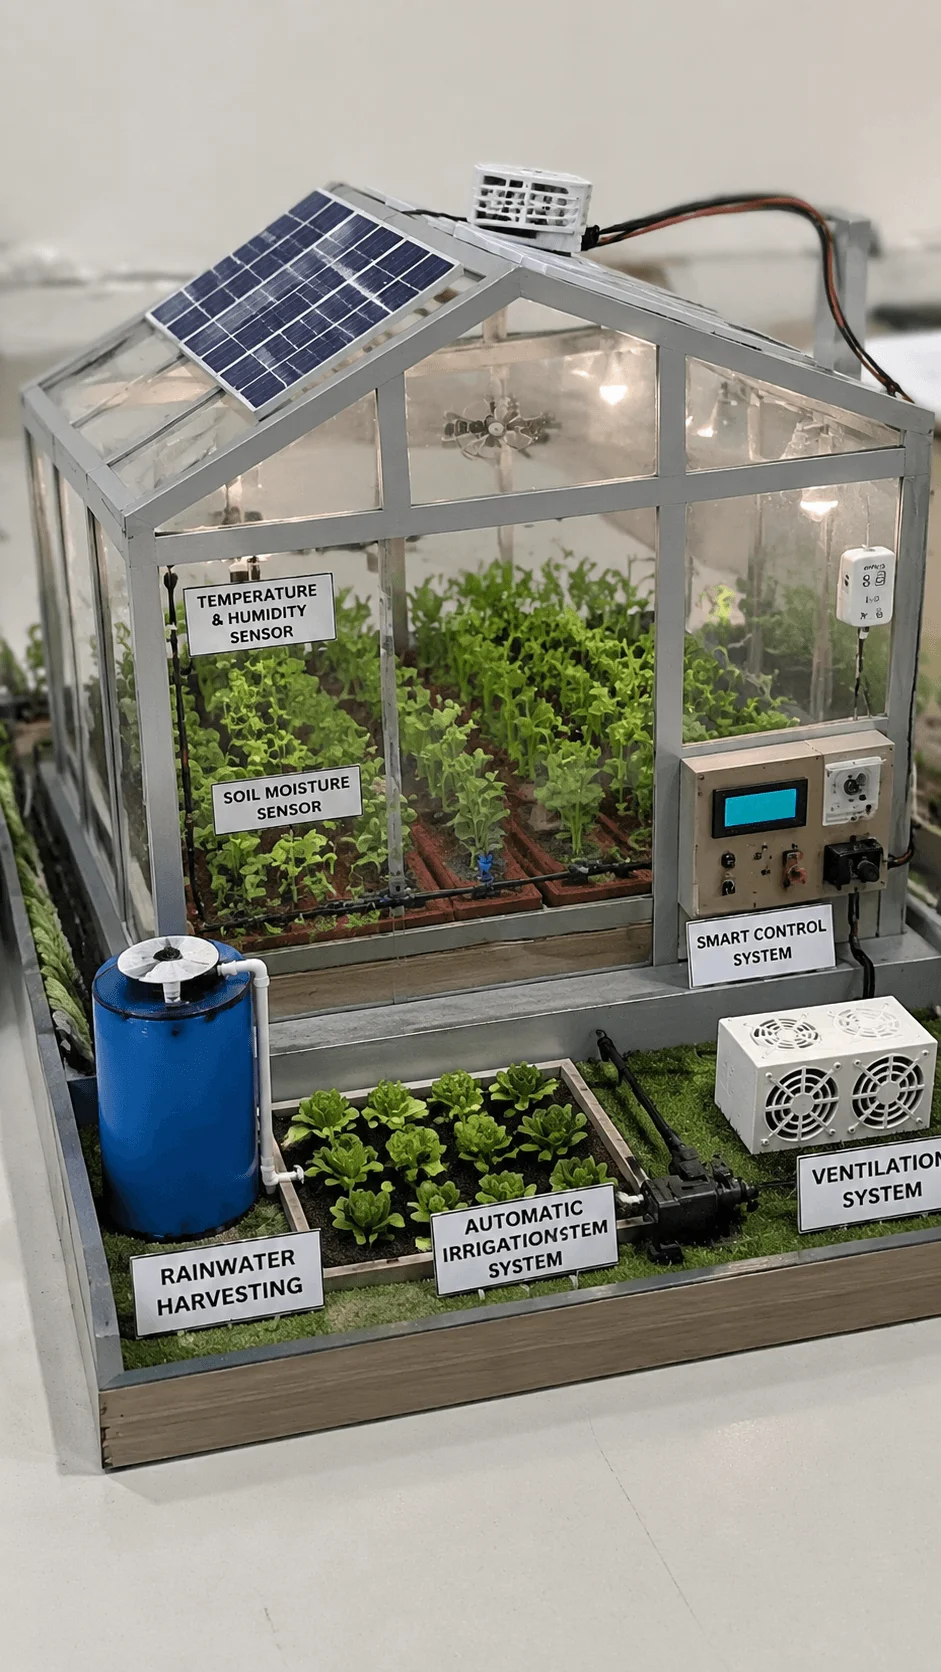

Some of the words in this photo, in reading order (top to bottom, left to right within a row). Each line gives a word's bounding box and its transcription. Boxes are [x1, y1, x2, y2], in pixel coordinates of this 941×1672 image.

[197, 584, 317, 608] TEMPERATURE
[212, 614, 223, 626] &
[228, 605, 307, 624] HUMIDITY
[230, 626, 293, 643] SENSOR
[224, 789, 260, 804] SOIL
[265, 776, 350, 799] MOISTURE
[257, 801, 322, 820] SENSOR
[697, 930, 749, 949] SMART
[754, 920, 826, 940] CONTROL
[733, 947, 792, 966] SYSTEM
[843, 1181, 922, 1208] SYSTEM
[465, 1200, 583, 1235] AUTOMATIC
[160, 1249, 295, 1285] RAINWATER
[489, 1251, 562, 1278] SYSTEM
[157, 1277, 303, 1316] HARVESTING
